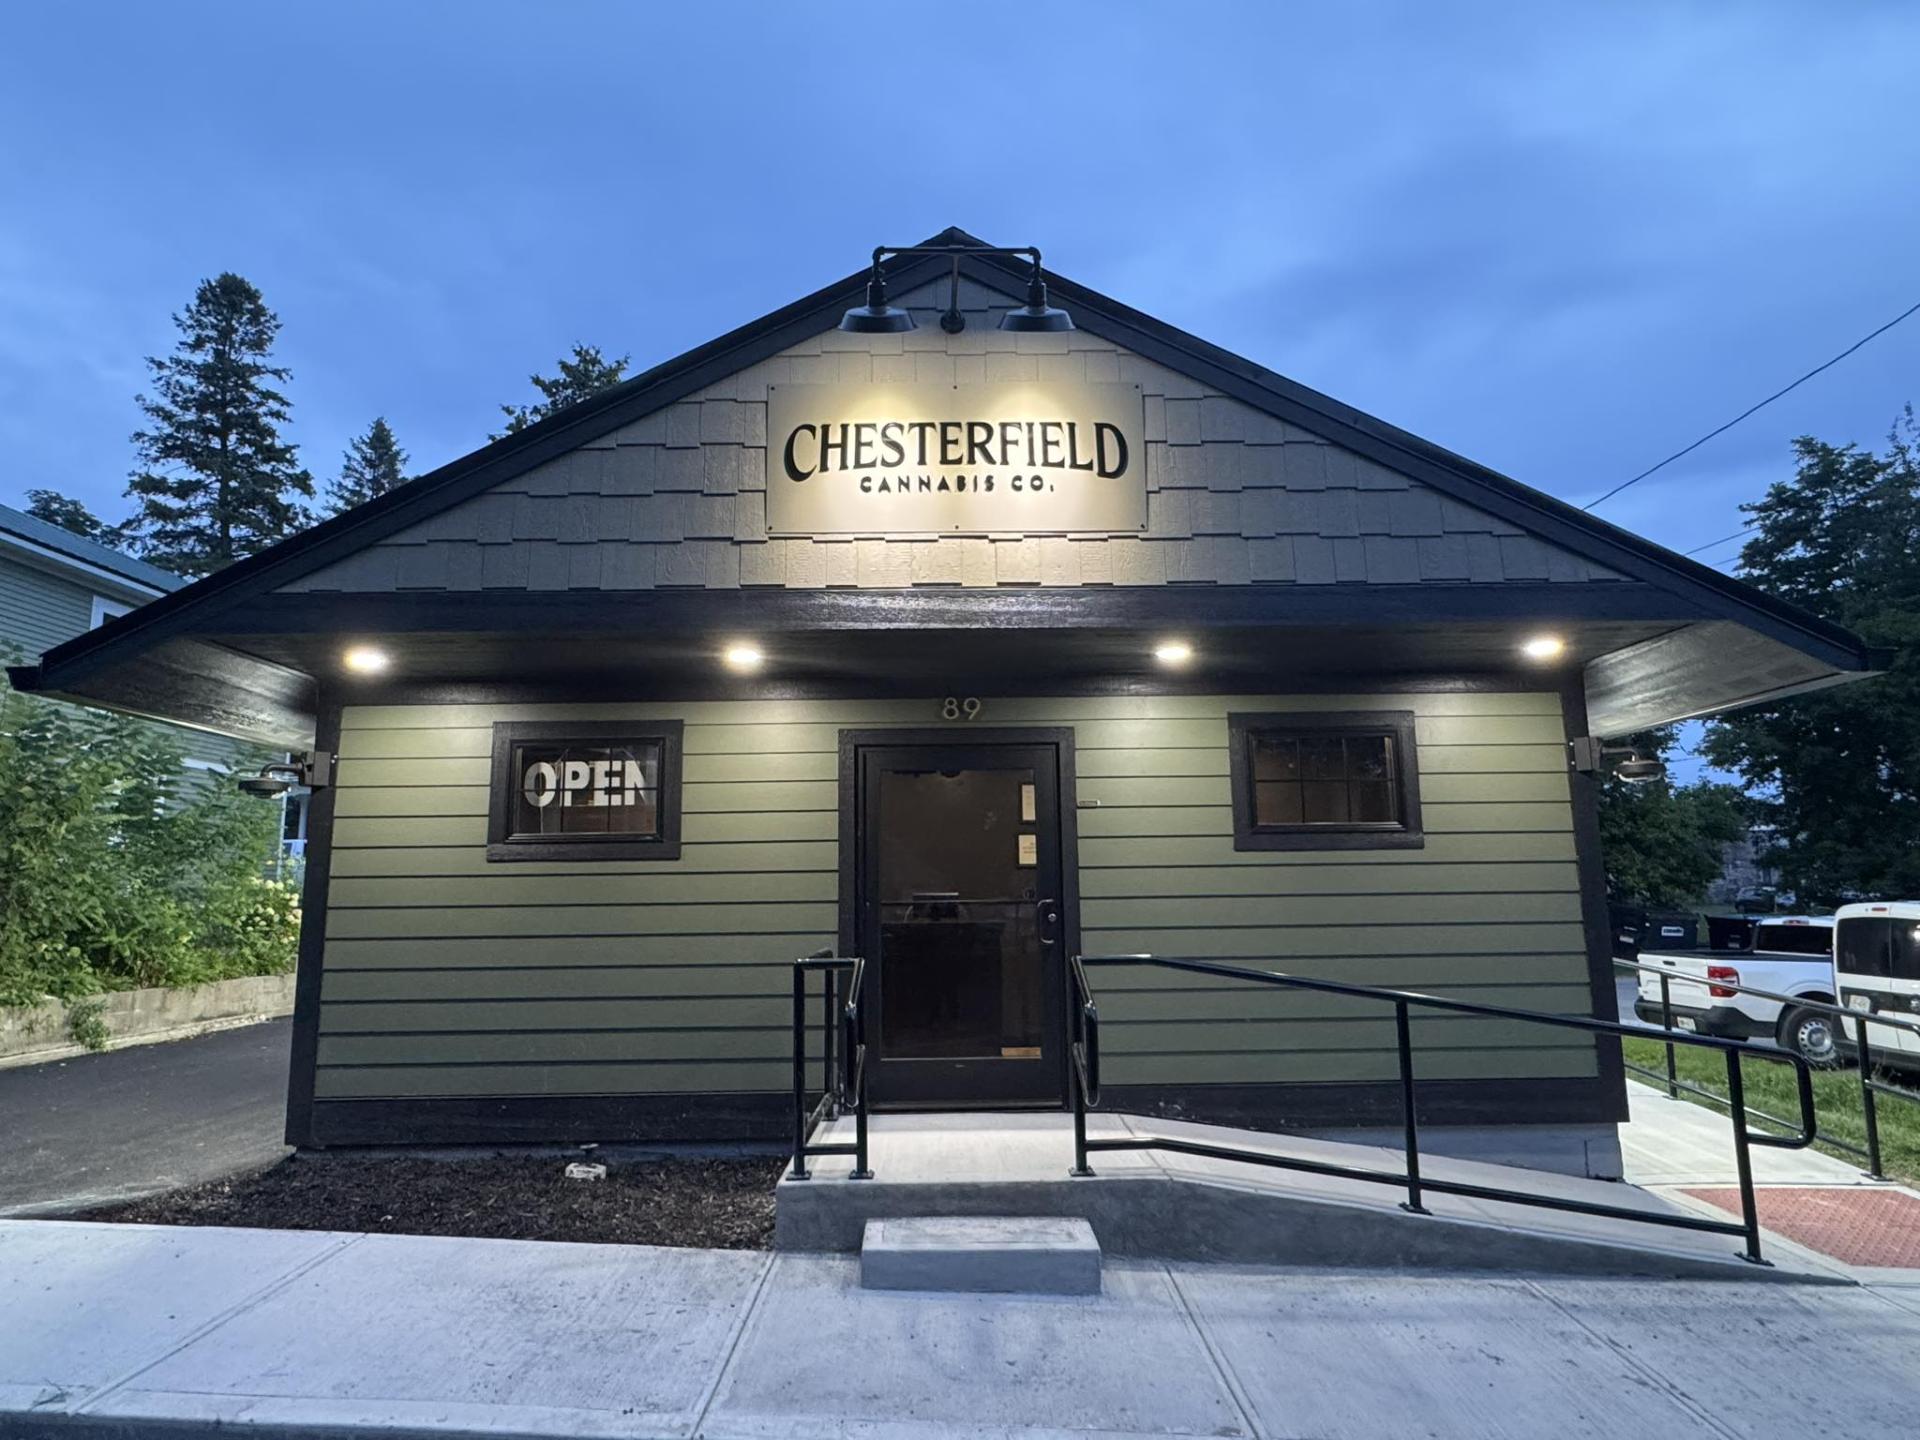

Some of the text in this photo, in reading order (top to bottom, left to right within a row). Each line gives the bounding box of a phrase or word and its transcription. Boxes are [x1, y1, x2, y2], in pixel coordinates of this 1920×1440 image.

[783, 421, 1129, 483] CHESTERFIELD
[860, 474, 1054, 493] CANNABIS CO.
[942, 697, 982, 721] 89
[524, 760, 657, 808] OPEN
